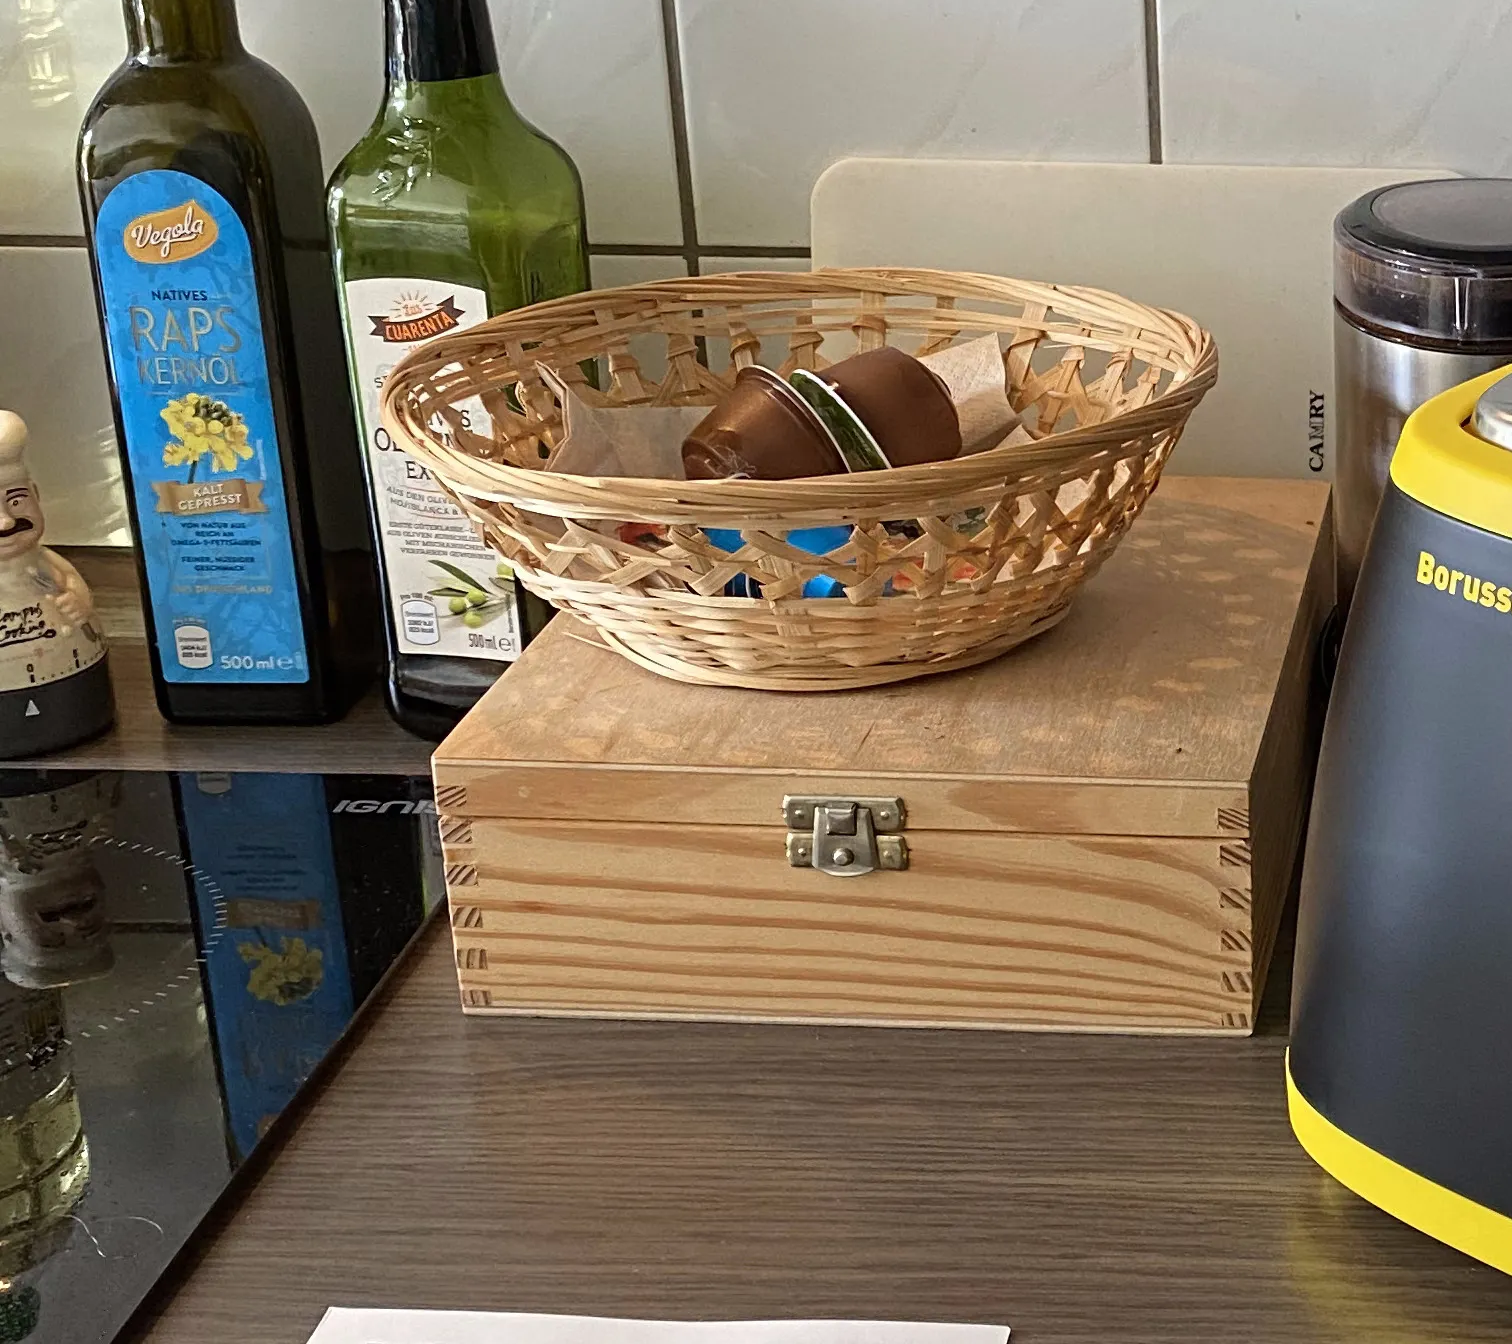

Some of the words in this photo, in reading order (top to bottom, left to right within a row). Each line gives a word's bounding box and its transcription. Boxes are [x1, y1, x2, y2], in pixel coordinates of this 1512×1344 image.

[130, 206, 204, 257] Vegola
[151, 290, 208, 301] NATIVES
[129, 306, 241, 352] RAPS
[385, 311, 454, 341] CUARENTA
[137, 353, 245, 385] KERNÖL
[1308, 389, 1324, 472] CAMRY
[177, 493, 242, 510] GEPRESST
[193, 483, 223, 497] KALT
[220, 655, 254, 670] 500
[256, 656, 275, 670] ml
